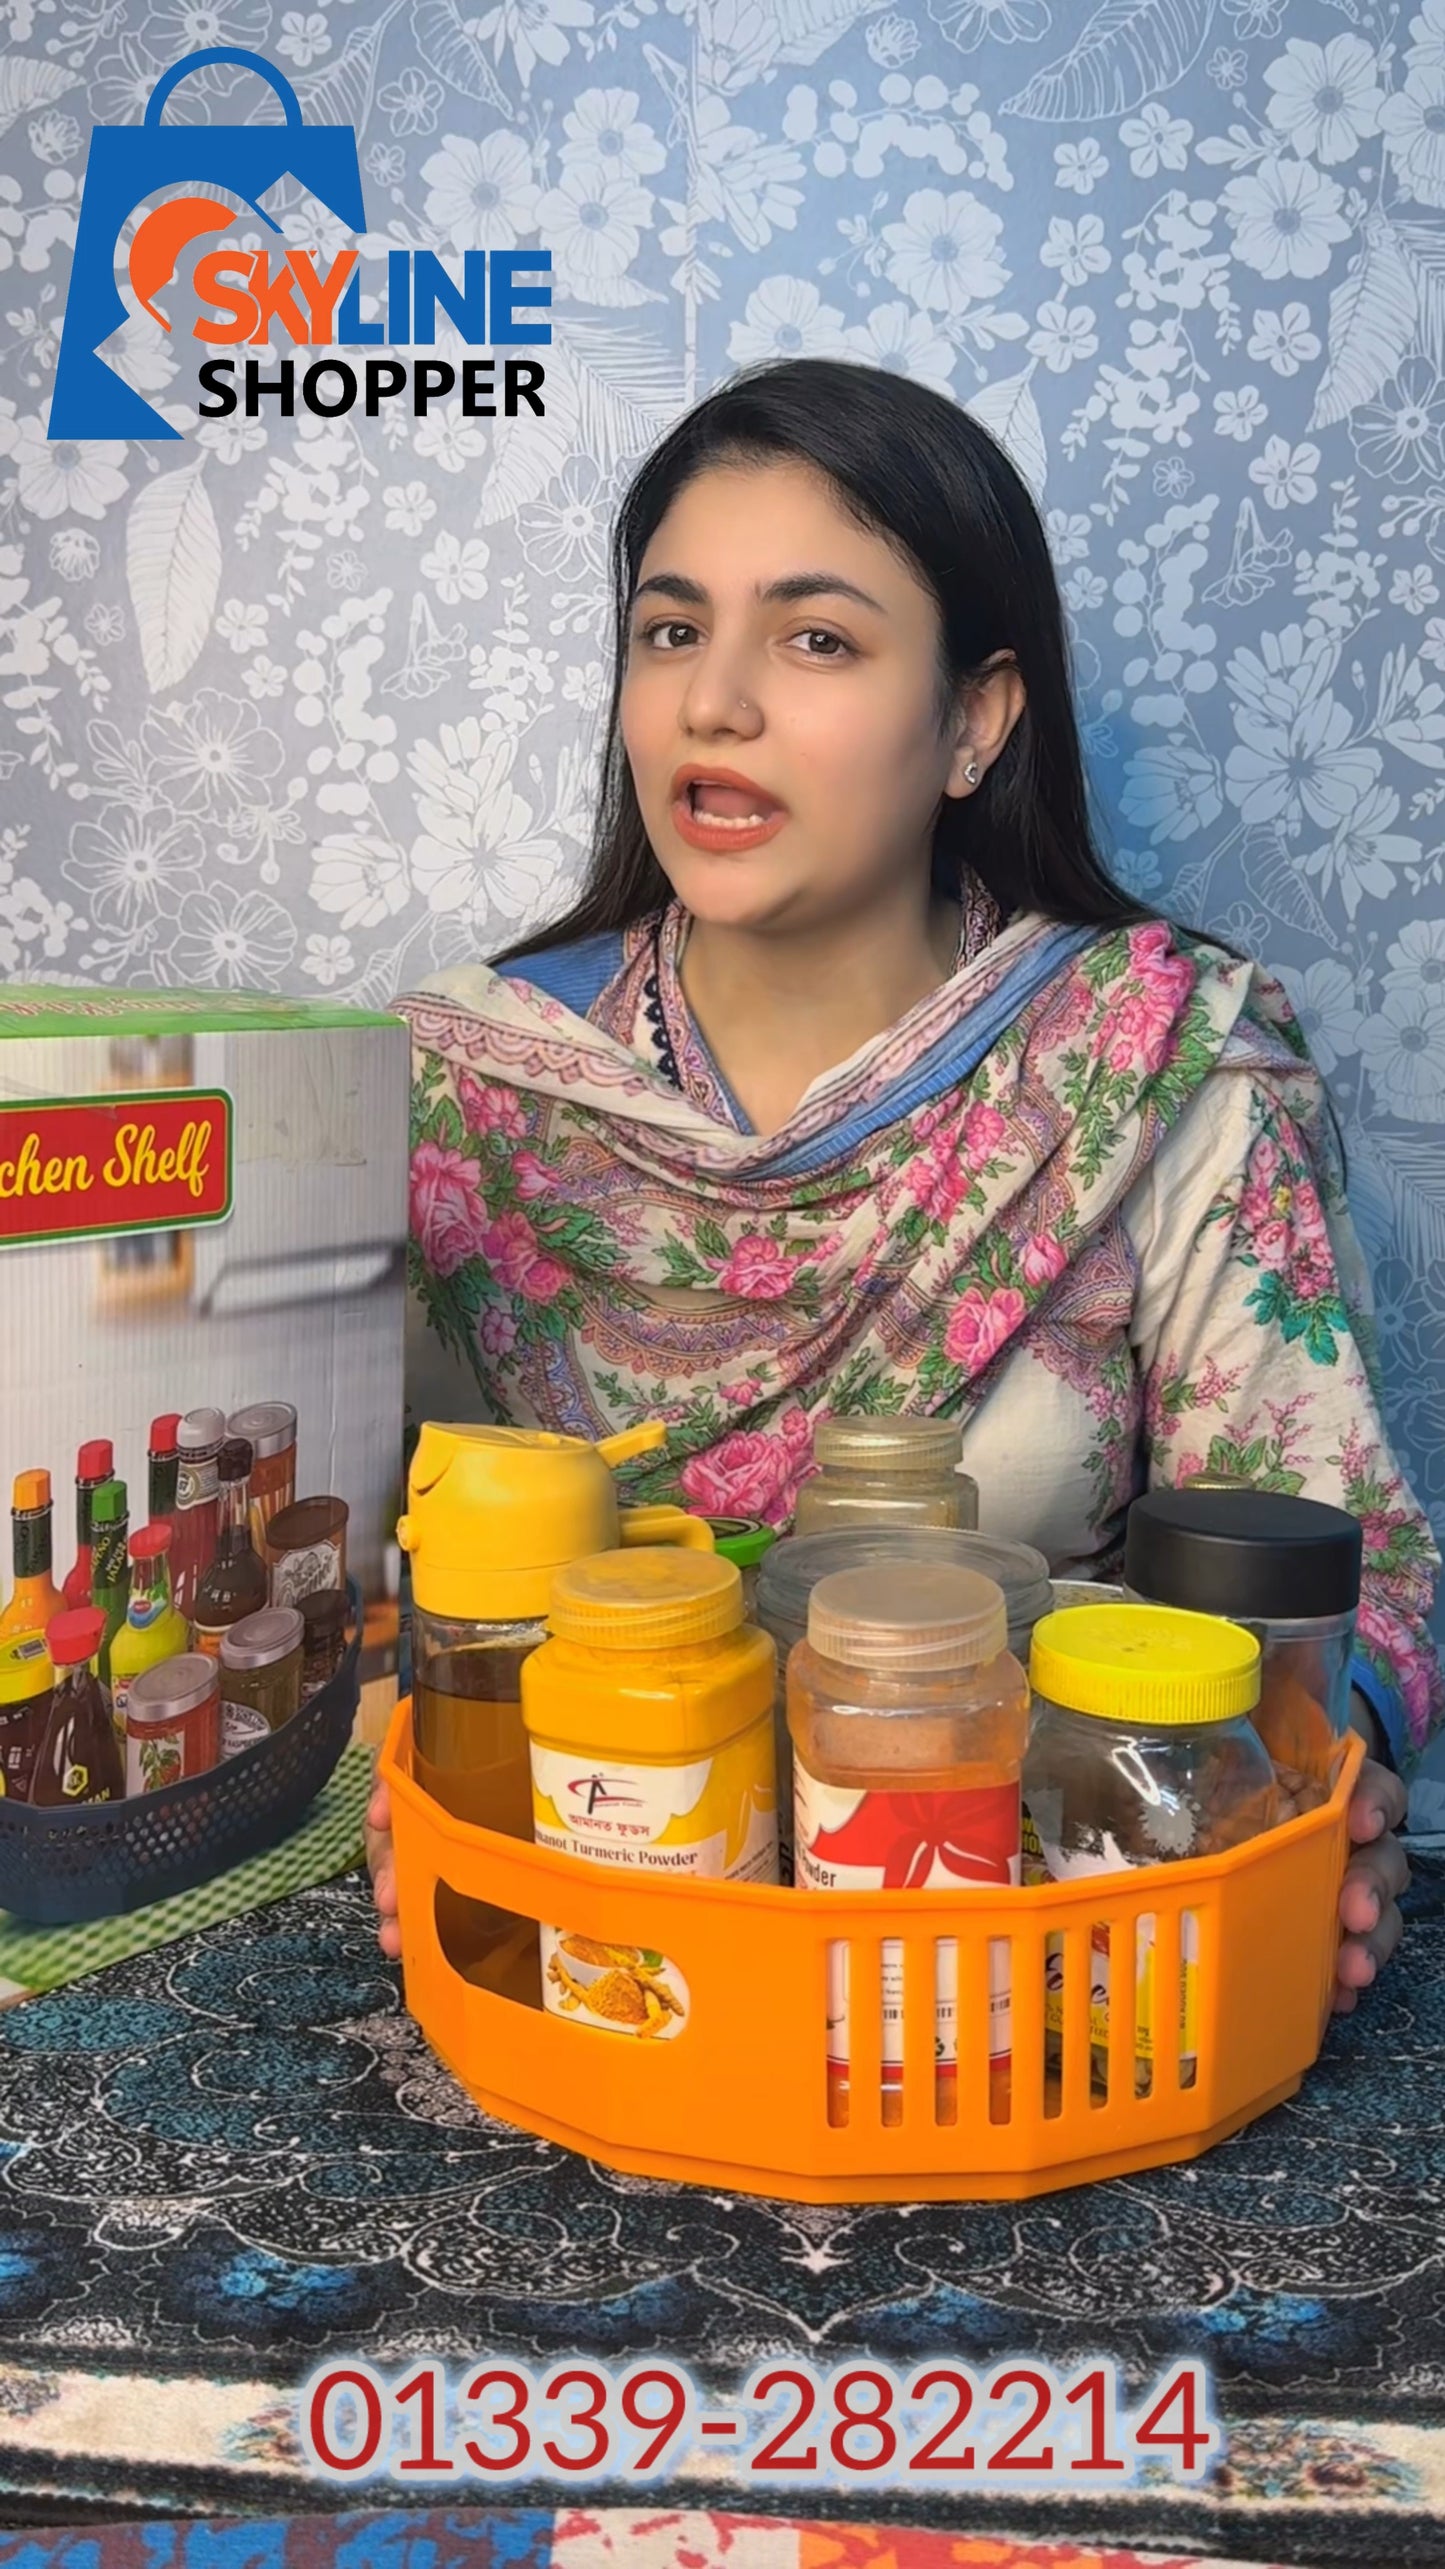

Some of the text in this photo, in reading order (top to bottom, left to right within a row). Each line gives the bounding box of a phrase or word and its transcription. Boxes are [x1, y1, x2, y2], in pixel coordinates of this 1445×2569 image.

[103, 1119, 213, 1198] Shelf
[571, 1839, 635, 1863] Turmeric
[638, 1850, 698, 1867] Powder
